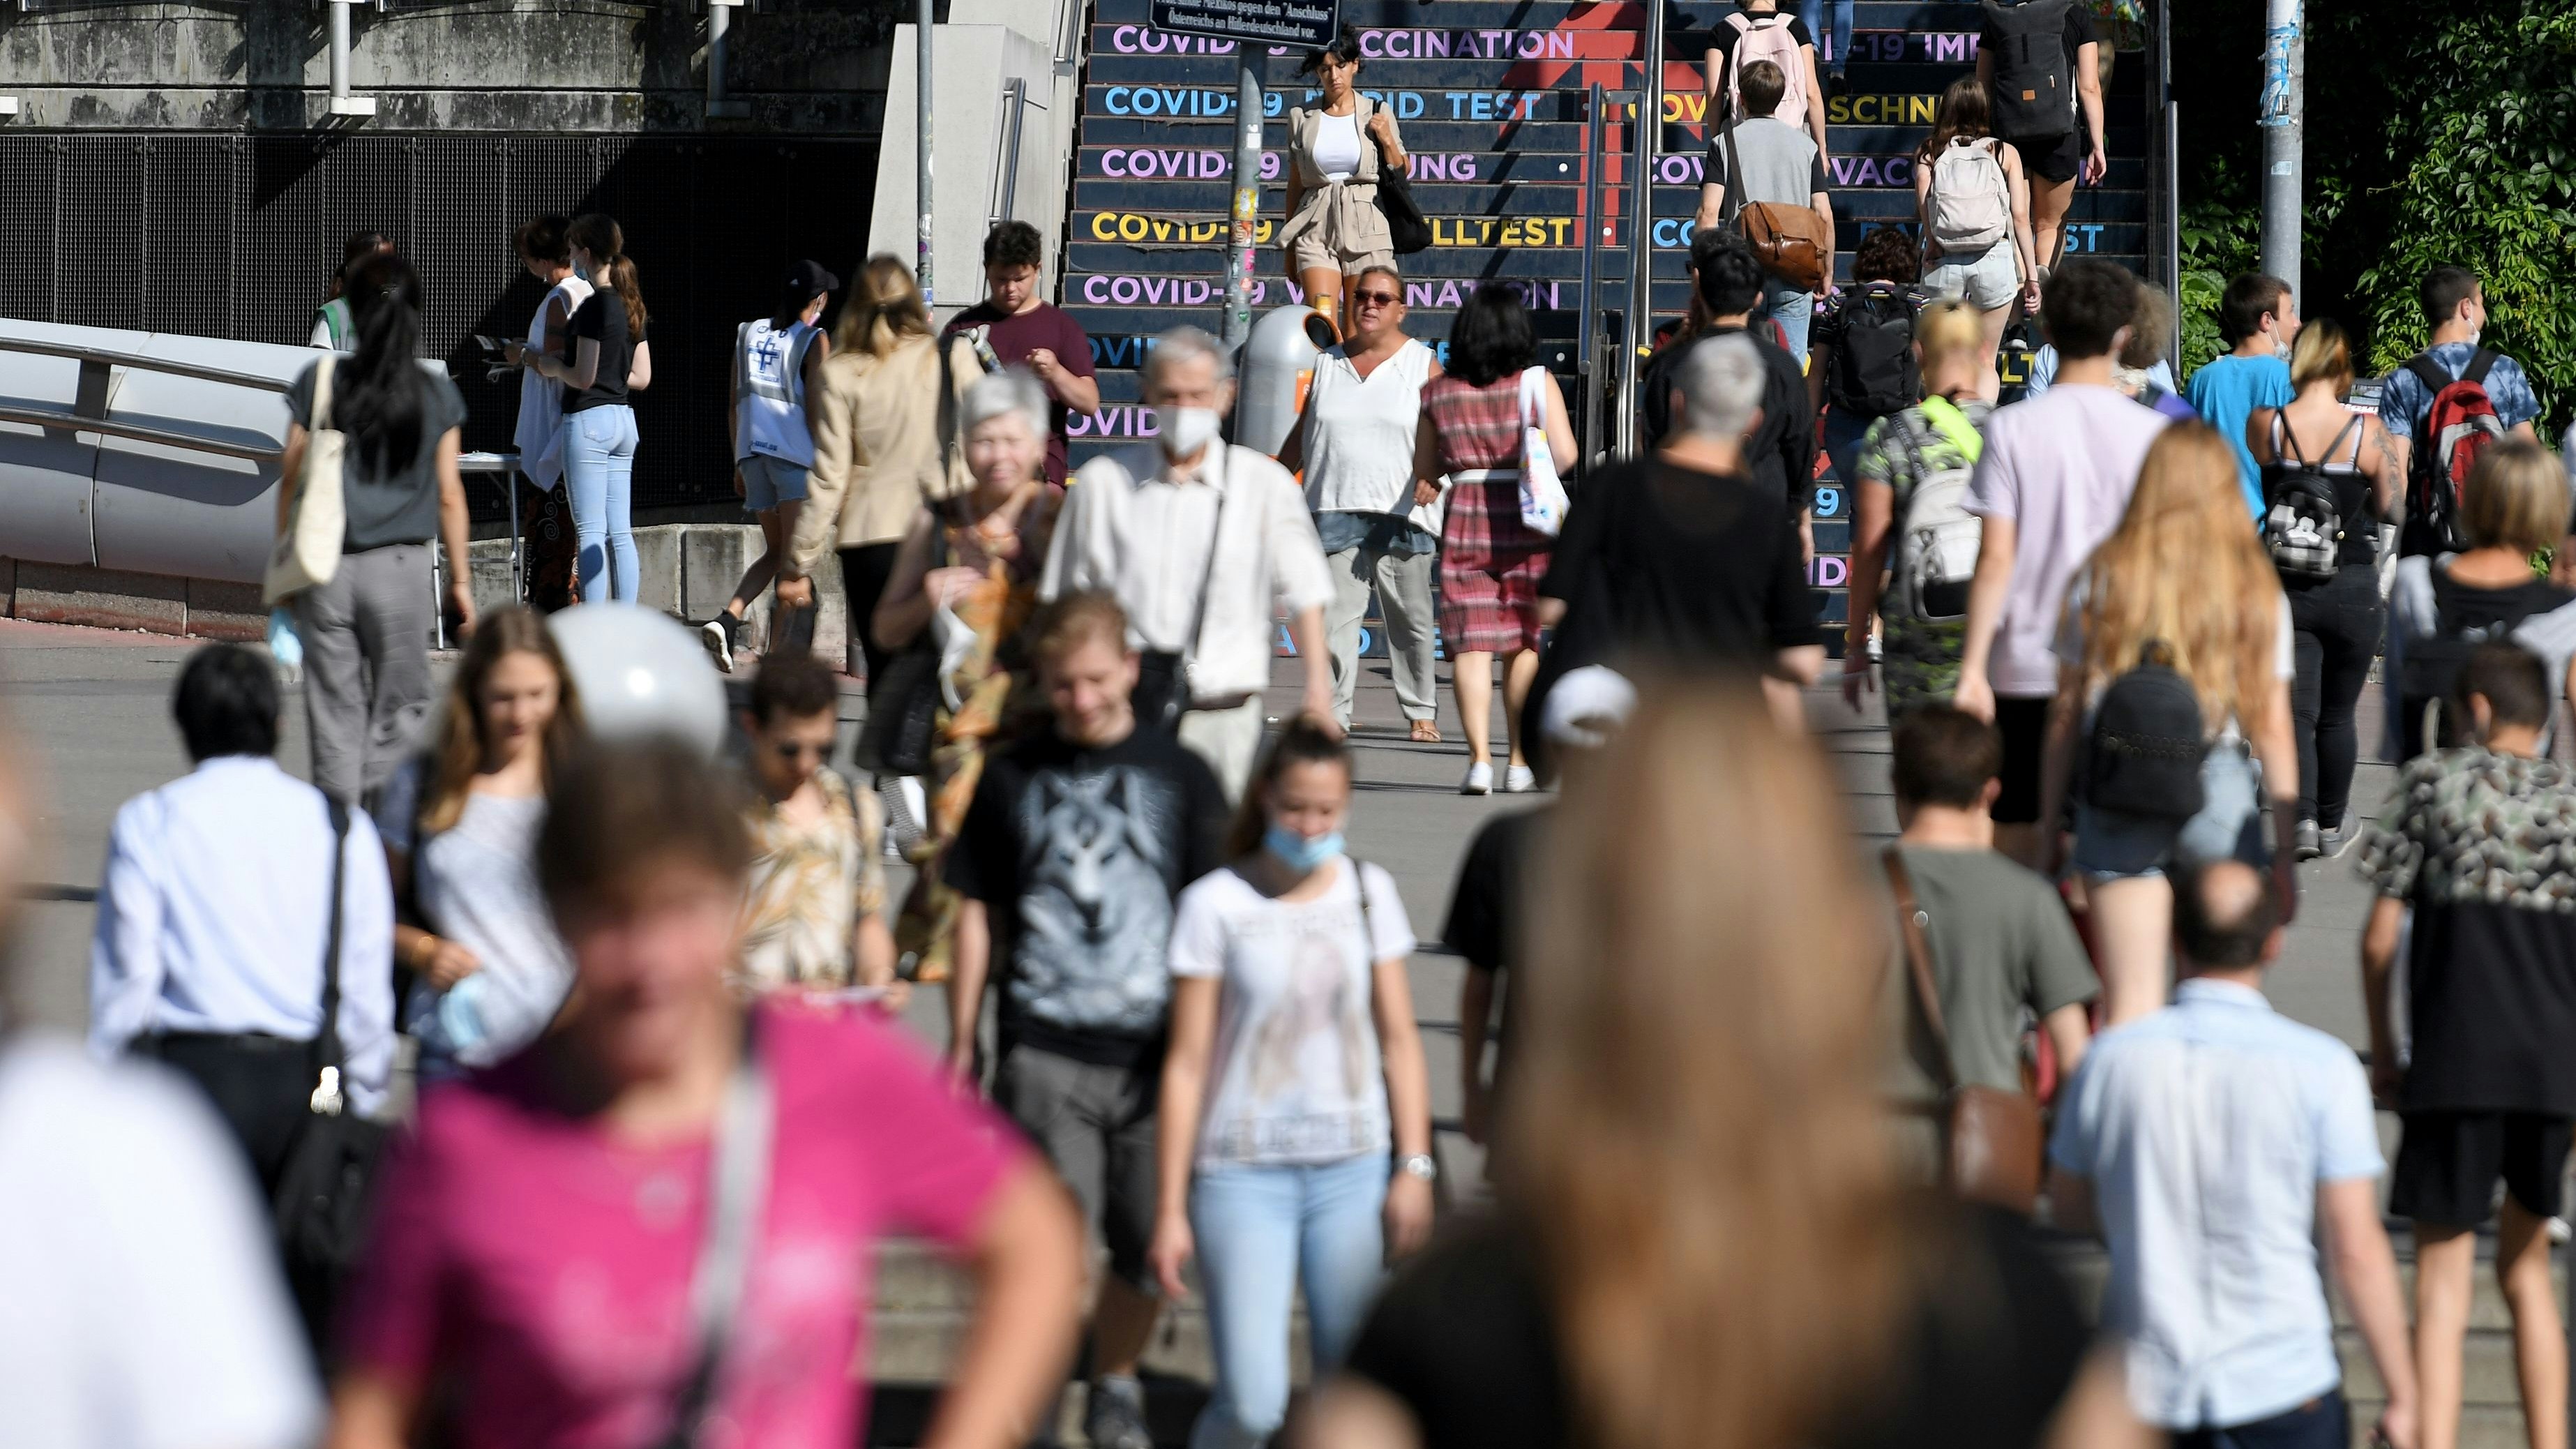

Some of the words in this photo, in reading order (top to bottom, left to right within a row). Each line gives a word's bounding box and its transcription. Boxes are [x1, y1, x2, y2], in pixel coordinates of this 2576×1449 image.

[1168, 7, 1214, 27] Österreichs
[1215, 18, 1226, 28] an
[1228, 15, 1300, 36] Hitlerdeutschland
[1301, 27, 1318, 38] vor.
[1237, 2, 1263, 15] gegen
[1264, 1, 1281, 15] den
[1113, 25, 1288, 55] COVID
[1359, 30, 1574, 59] CCINATION
[1446, 92, 1540, 120] TEST
